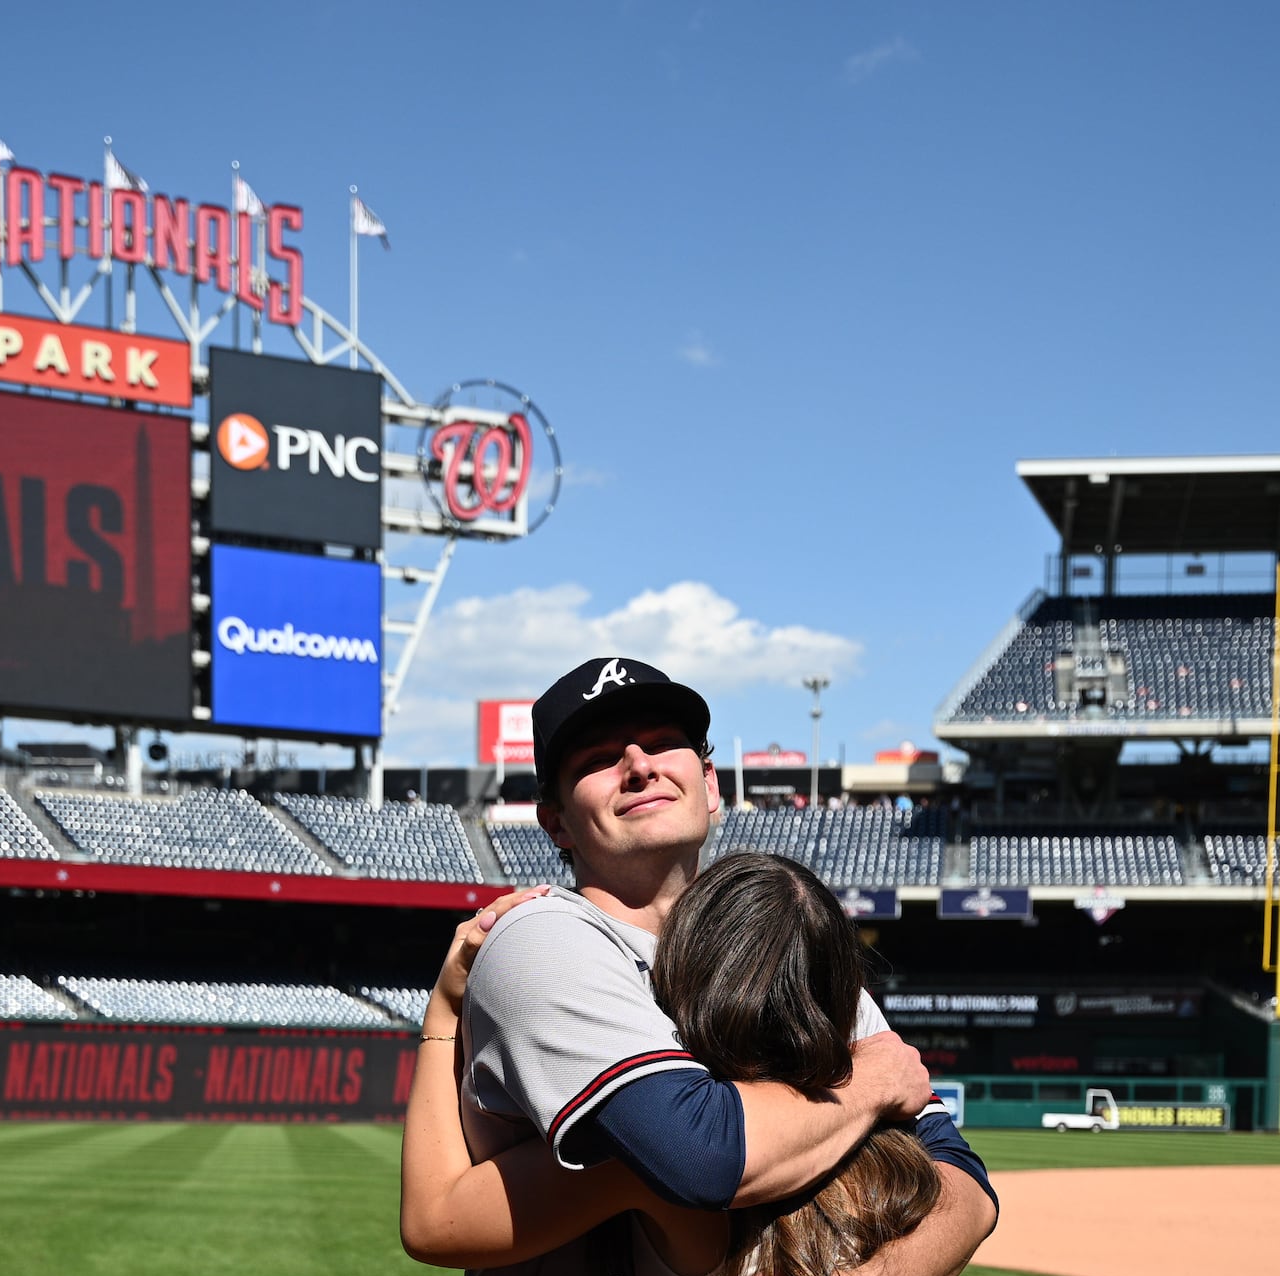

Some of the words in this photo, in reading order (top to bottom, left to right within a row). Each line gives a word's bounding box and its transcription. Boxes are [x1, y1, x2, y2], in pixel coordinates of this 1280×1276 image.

[272, 424, 380, 483] PNC
[218, 616, 379, 664] Qualcomm
[582, 658, 627, 701] A
[491, 745, 534, 760] TOYOT
[884, 994, 933, 1011] WELCOME
[936, 994, 950, 1011] TO
[951, 994, 1008, 1011] NATIONALS
[1009, 994, 1039, 1012] PARK
[4, 1041, 178, 1103] NATIONALS
[204, 1046, 366, 1104] NATIONALS
[1177, 1107, 1224, 1126] FENCE
